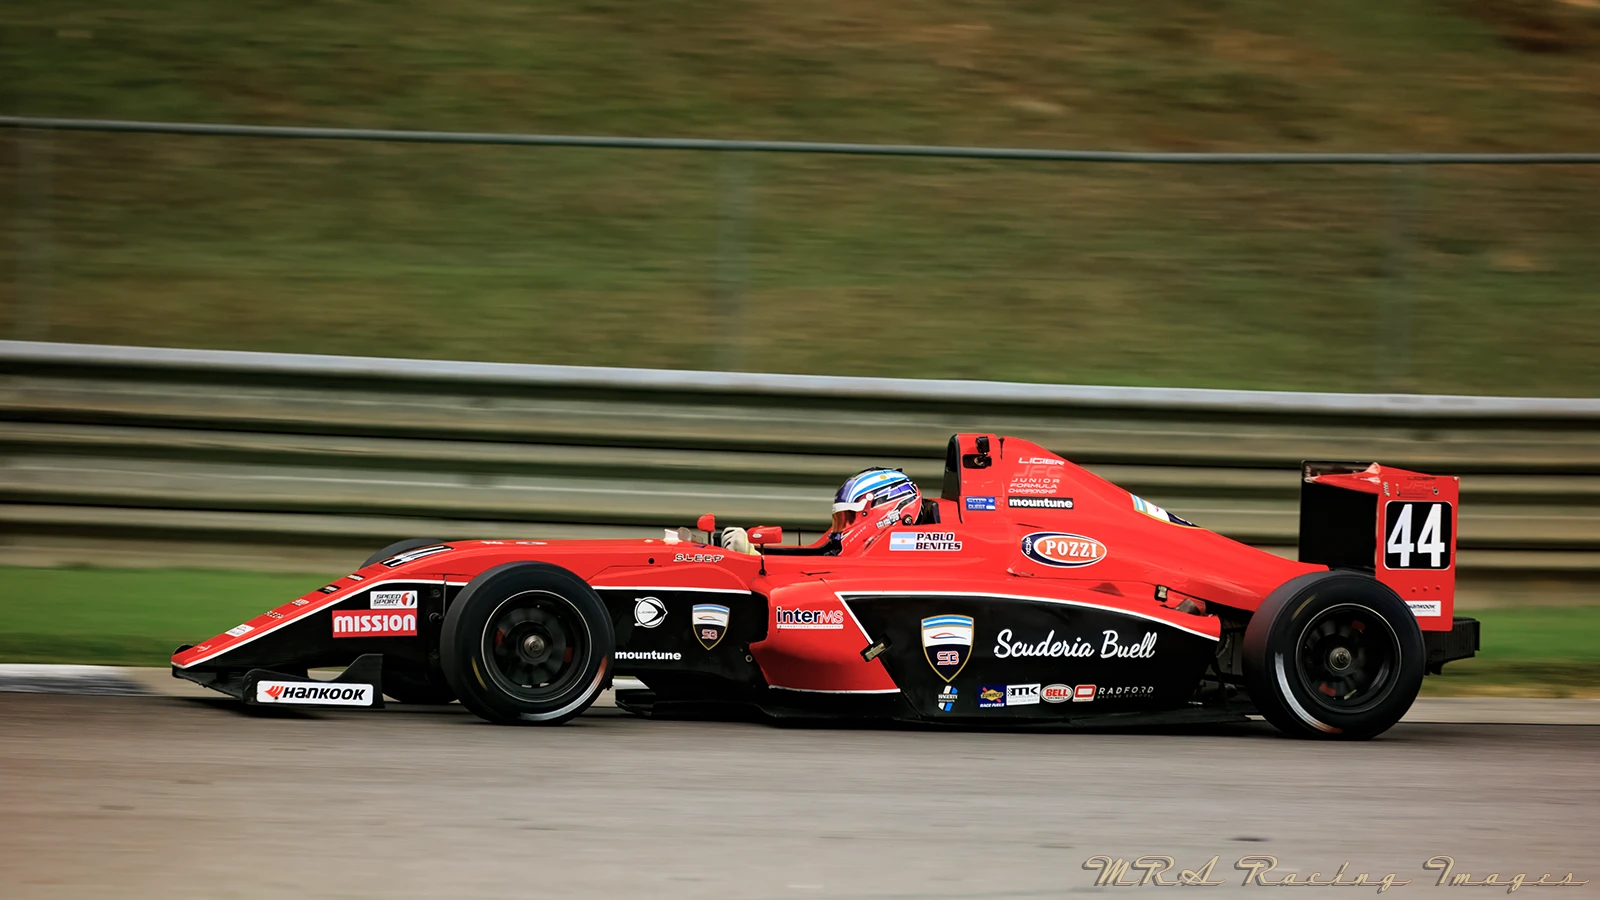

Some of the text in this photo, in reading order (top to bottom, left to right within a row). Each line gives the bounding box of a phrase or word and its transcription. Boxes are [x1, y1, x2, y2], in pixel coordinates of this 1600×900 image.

[1013, 465, 1064, 478] JFC
[1009, 498, 1073, 508] mountune
[916, 532, 955, 541] PABLO
[1387, 503, 1446, 567] 44
[915, 541, 962, 551] BENITES
[1045, 540, 1098, 558] POZZI
[993, 628, 1158, 659] Scuderia Buell
[614, 650, 682, 661] mountune
[1045, 688, 1068, 697] BELL
[1098, 686, 1154, 695] RADFORD
